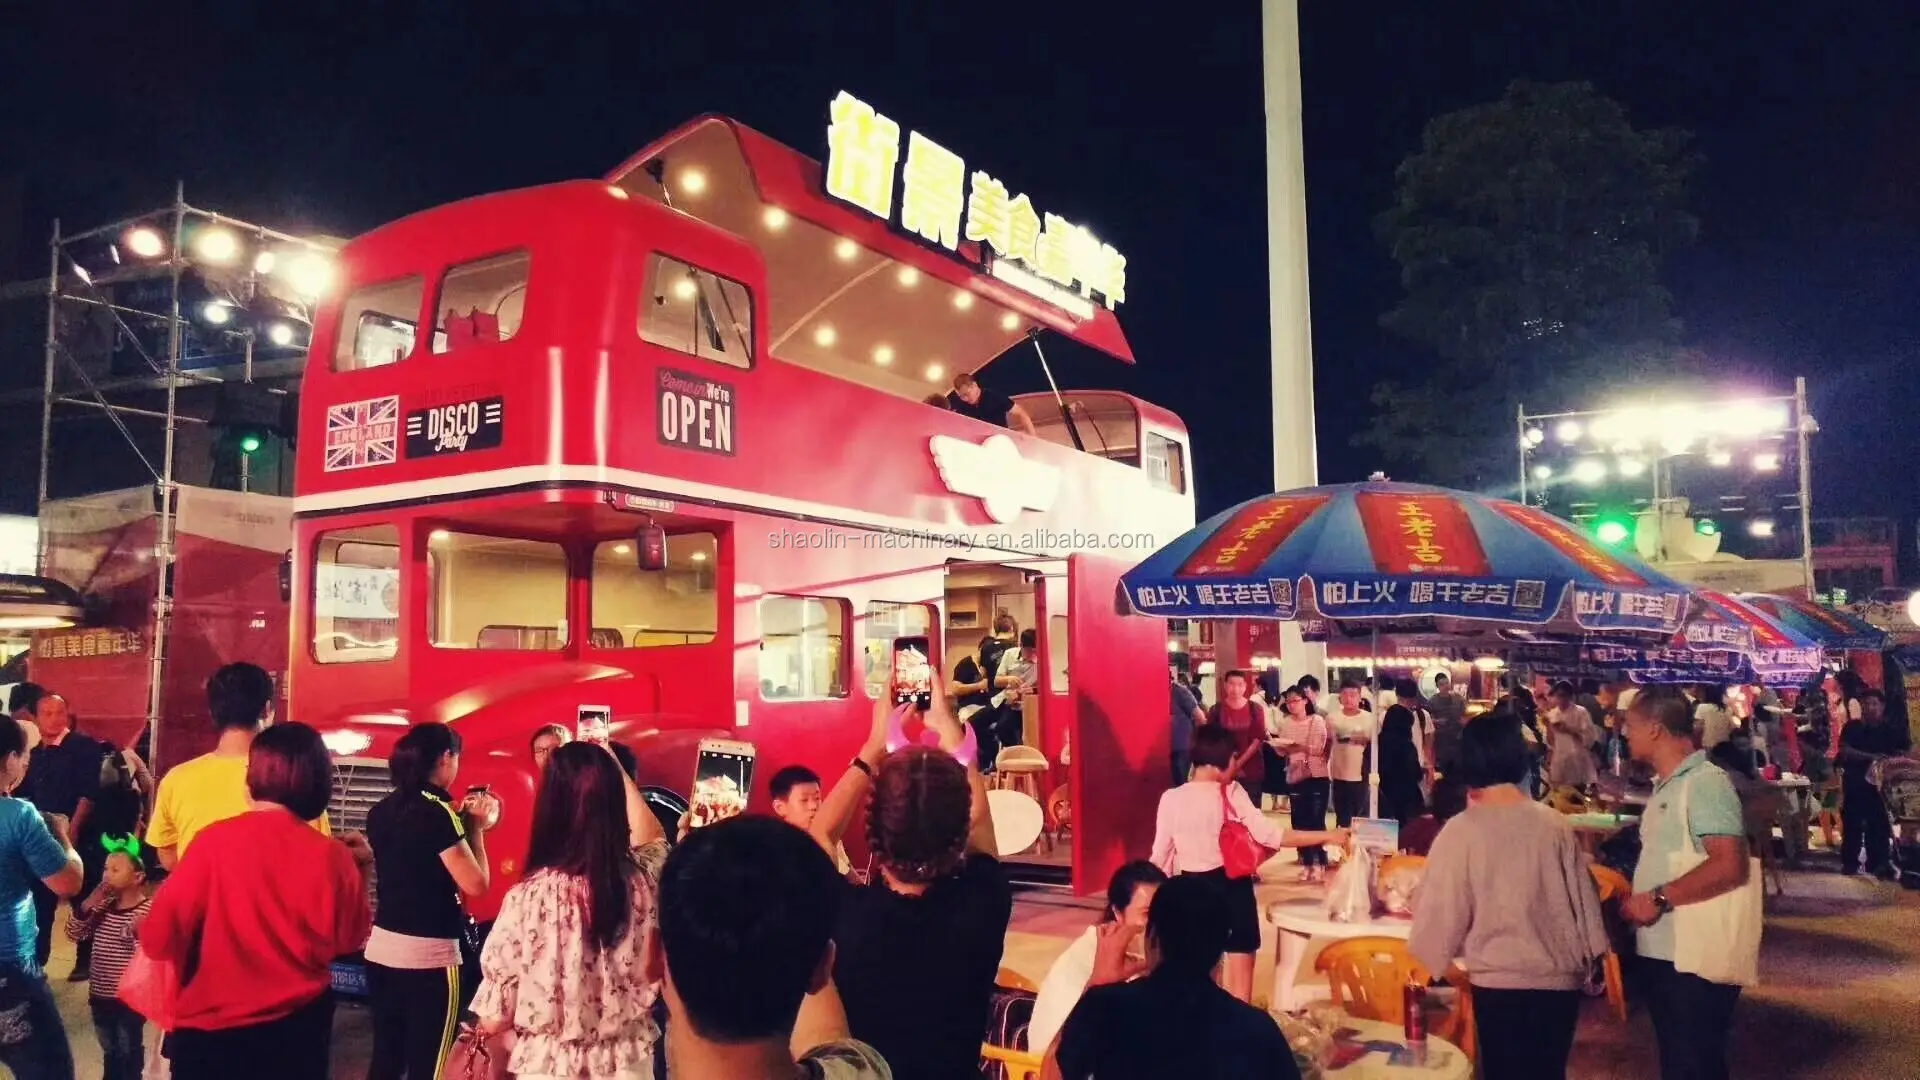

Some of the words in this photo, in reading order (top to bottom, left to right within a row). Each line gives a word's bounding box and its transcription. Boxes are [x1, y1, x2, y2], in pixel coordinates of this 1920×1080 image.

[706, 383, 730, 403] We're
[334, 423, 392, 445] ENGLAND
[428, 402, 479, 441] DISCO
[662, 391, 732, 452] OPEN
[435, 431, 468, 452] Party
[1215, 503, 1293, 564] 王老吉
[1396, 501, 1446, 563] 王老吉
[1137, 584, 1192, 607] 怕上火
[1195, 583, 1270, 605] 喝王老吉
[1323, 580, 1397, 604] 怕上火
[1409, 581, 1511, 605] 喝王老吉
